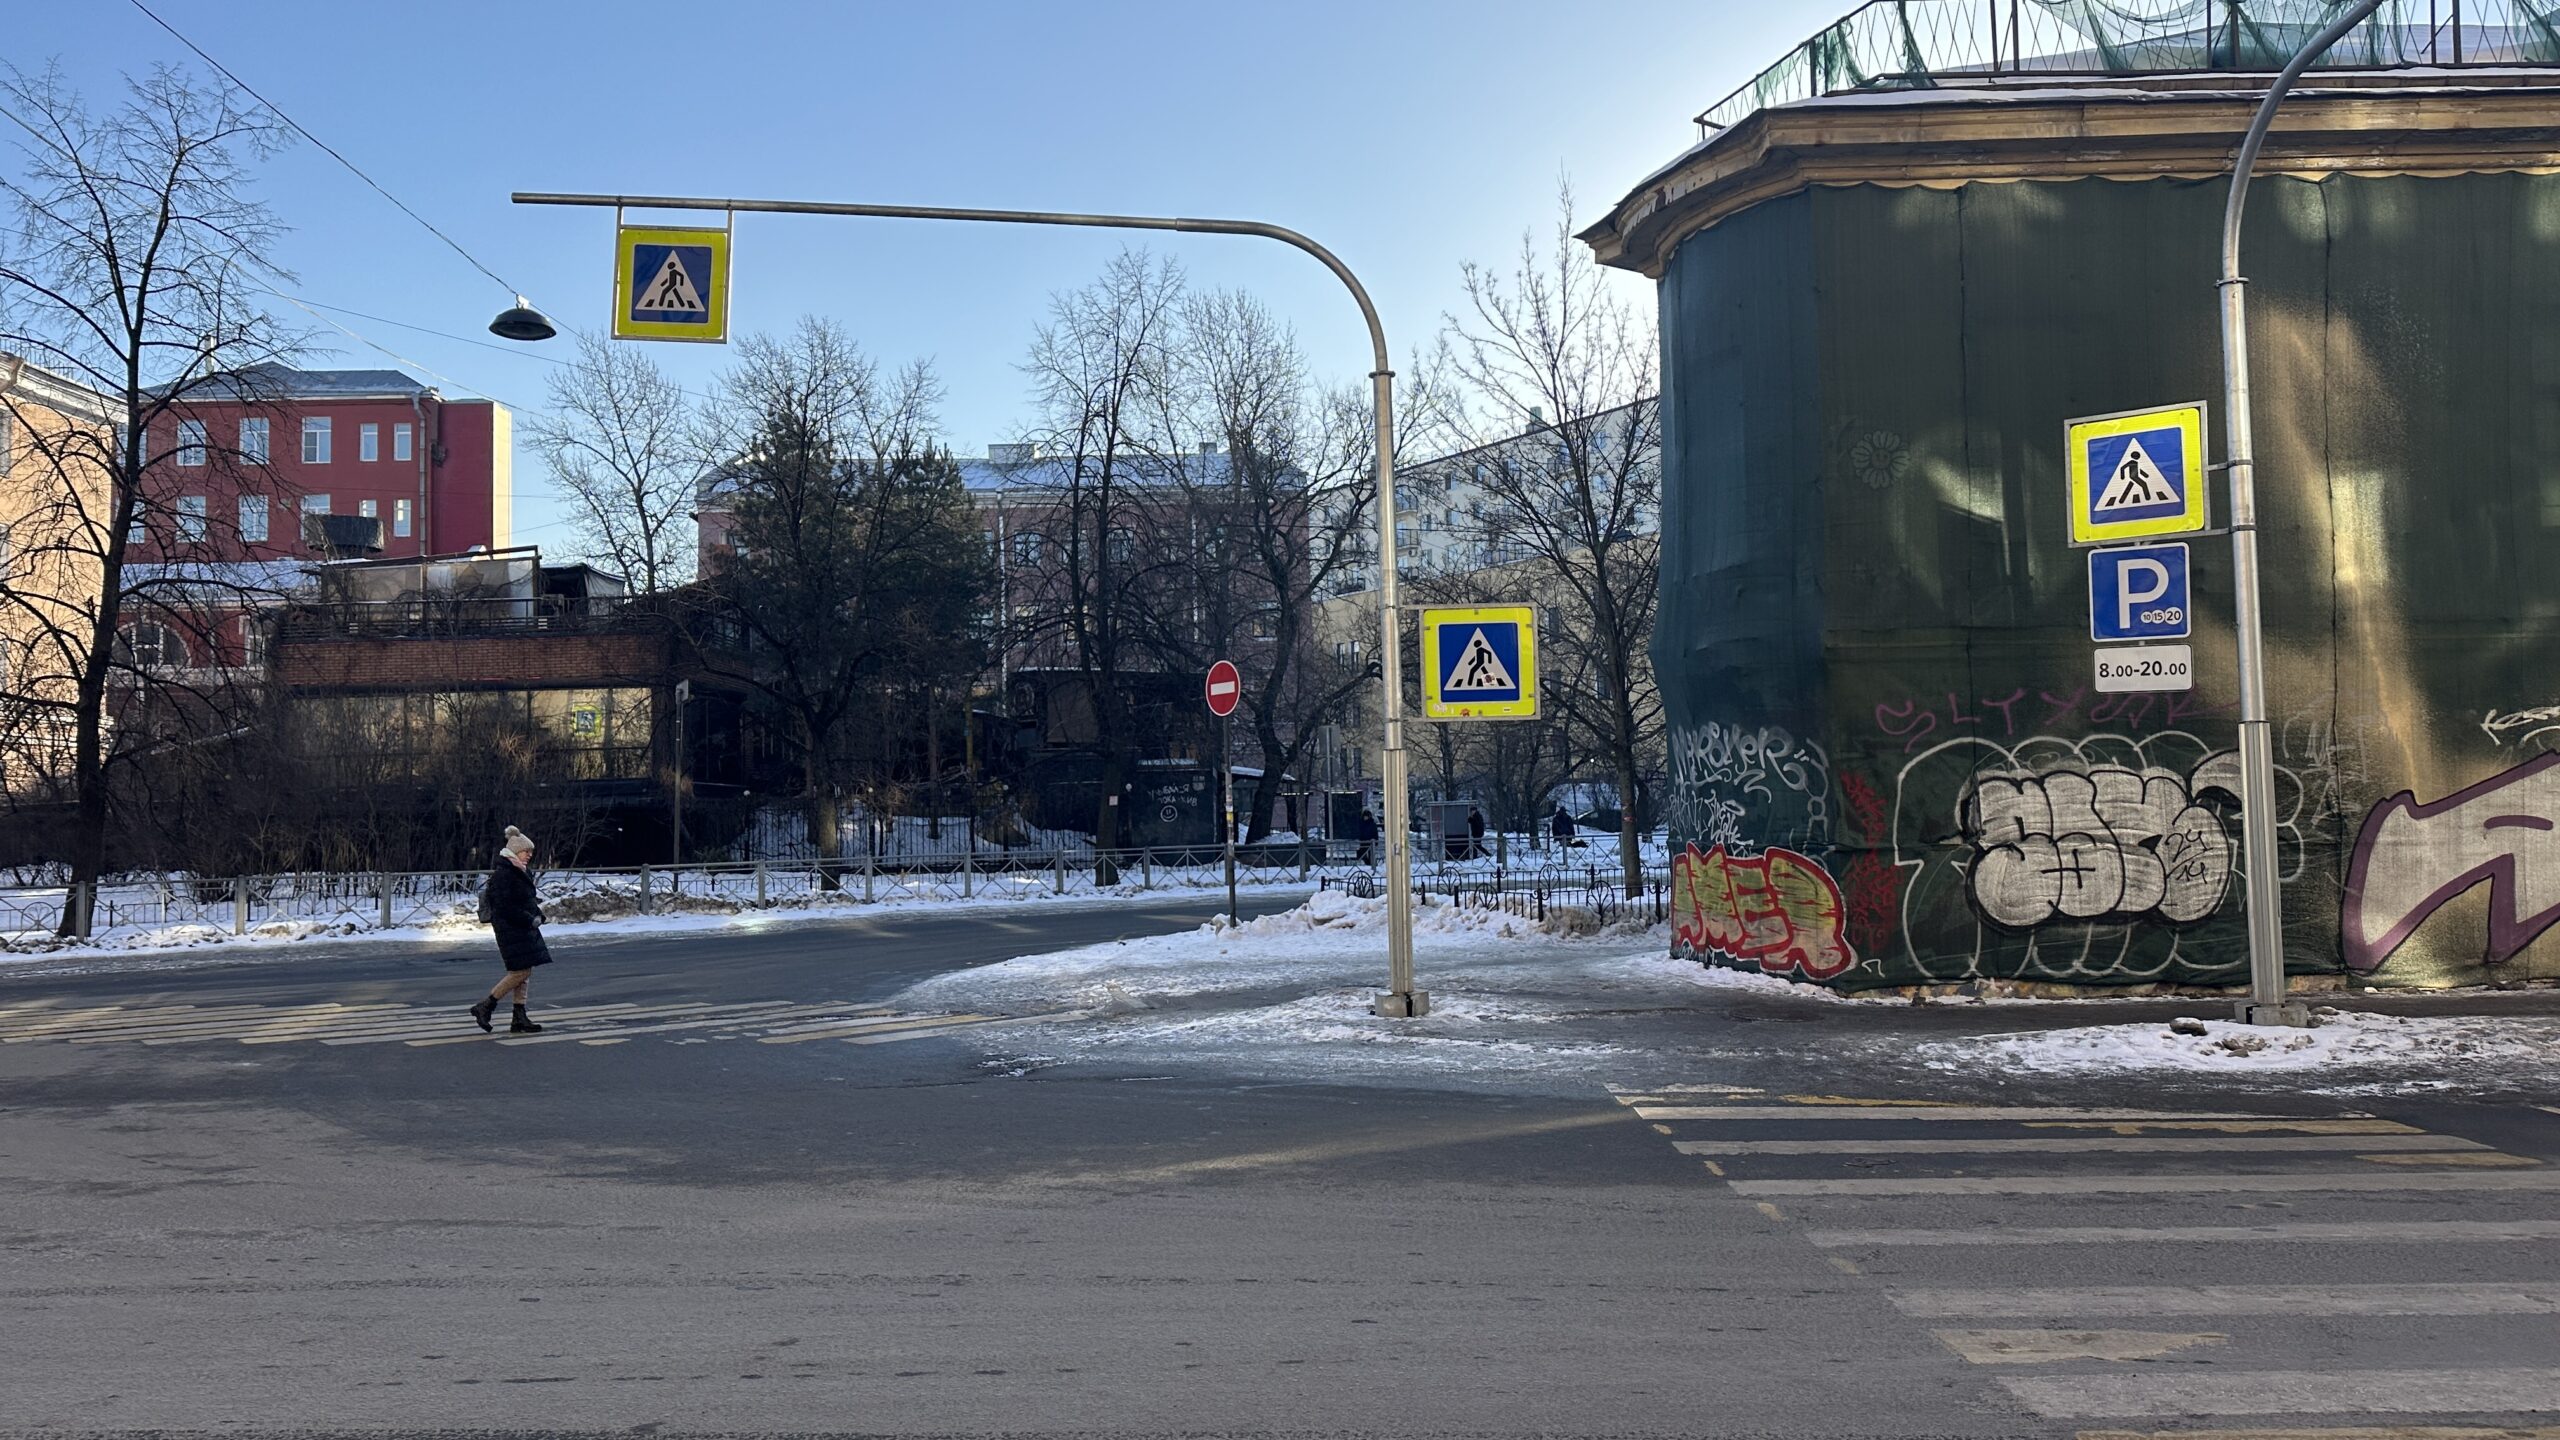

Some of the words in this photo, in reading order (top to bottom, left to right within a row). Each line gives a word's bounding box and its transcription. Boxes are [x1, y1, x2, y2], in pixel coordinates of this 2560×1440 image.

[2118, 558, 2169, 629] P
[2153, 612, 2163, 621] 15
[2166, 610, 2181, 621] 20
[2099, 661, 2187, 678] 8.00-20.00
